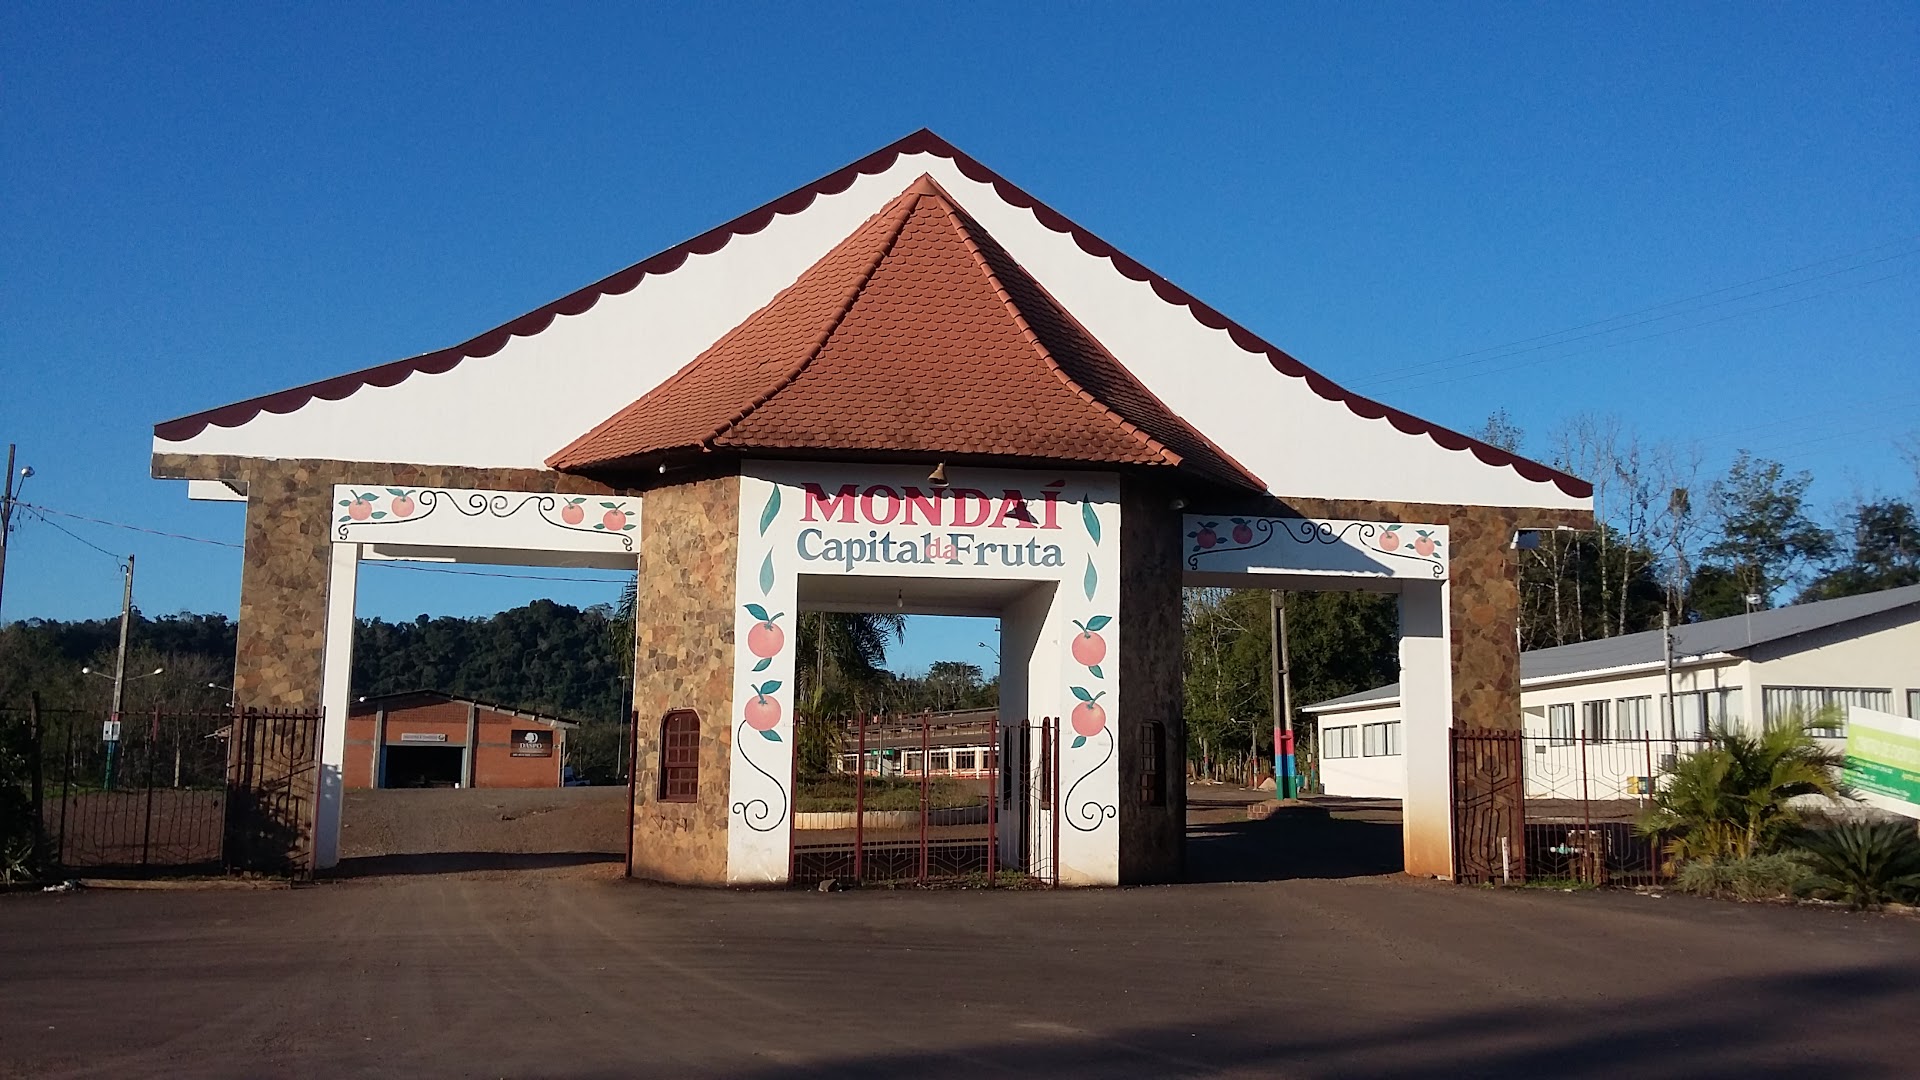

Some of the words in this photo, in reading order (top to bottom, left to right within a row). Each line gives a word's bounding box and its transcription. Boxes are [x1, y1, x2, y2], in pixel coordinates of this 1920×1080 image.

[799, 479, 1065, 530] MONDAÍ
[796, 528, 933, 573] Capital
[925, 537, 957, 560] da
[946, 533, 1066, 568] Fruta
